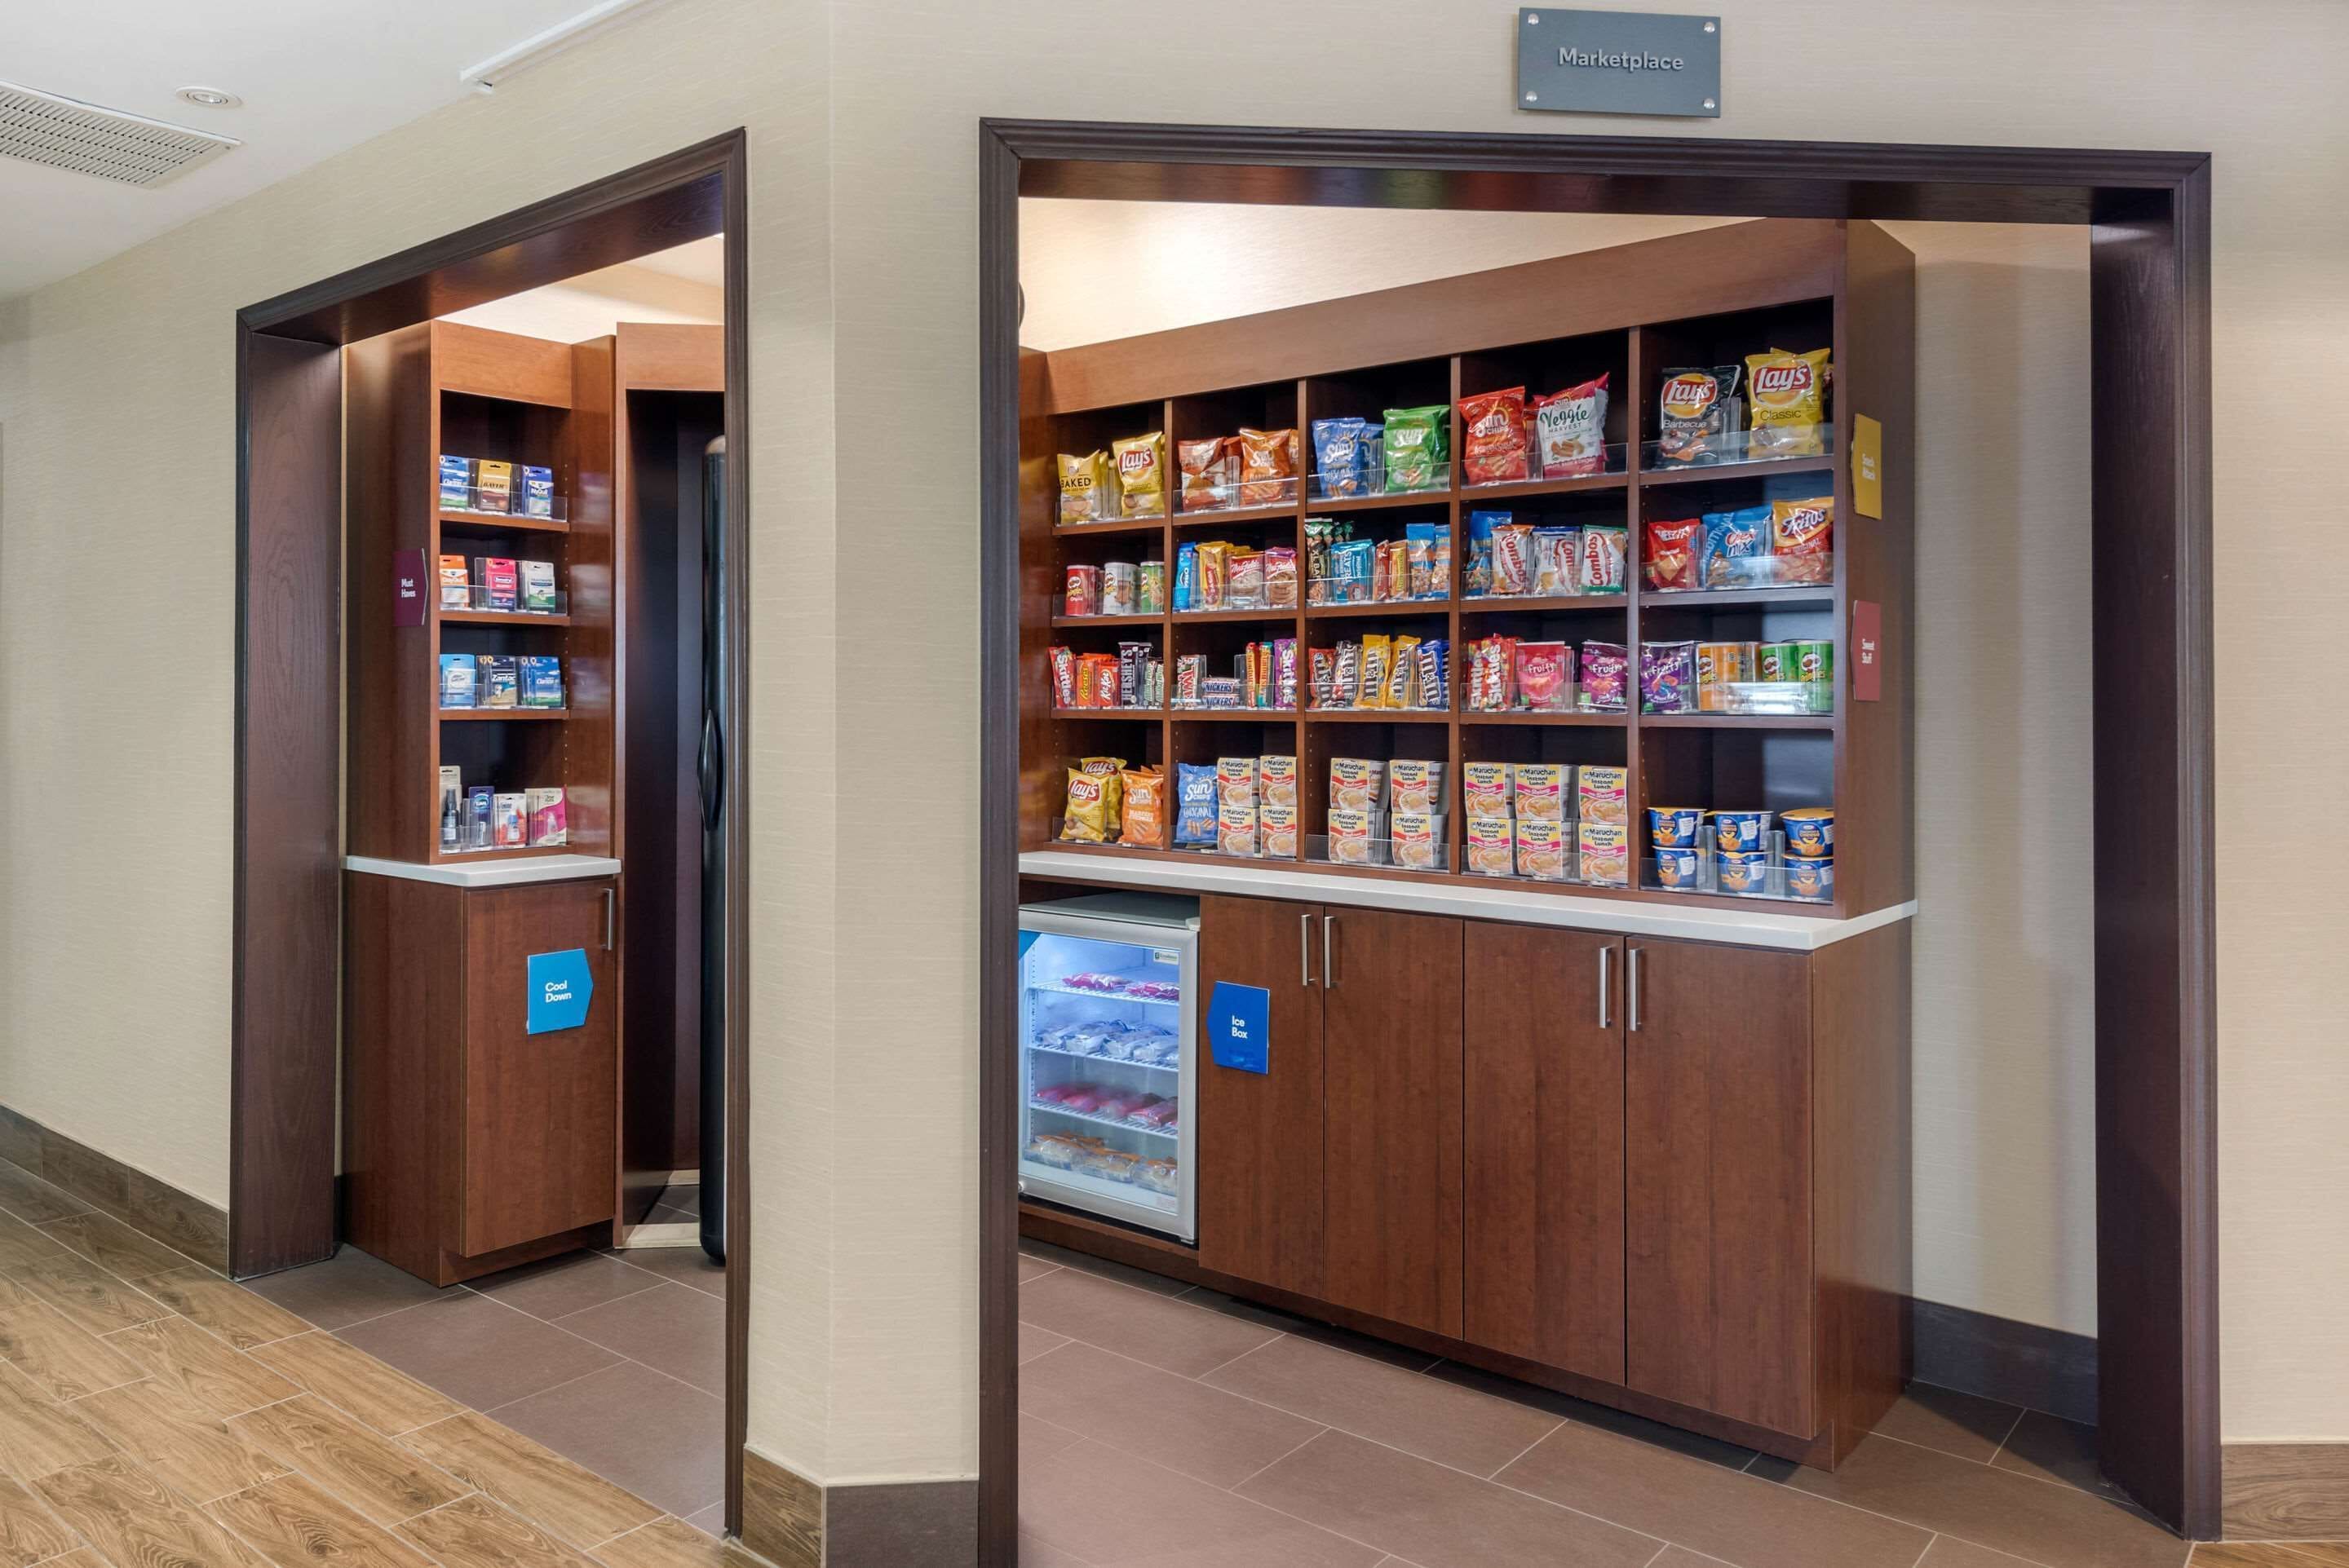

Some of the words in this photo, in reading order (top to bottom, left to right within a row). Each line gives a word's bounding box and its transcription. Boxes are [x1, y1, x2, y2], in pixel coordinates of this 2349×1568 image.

[1558, 47, 1684, 72] Marketplace
[1755, 365, 1808, 394] Lay's
[1540, 404, 1590, 428] Veggie
[1760, 409, 1802, 422] Classic
[1548, 422, 1582, 433] HARVEST
[1663, 420, 1707, 429] Barbecue
[1121, 447, 1151, 473] Lay's
[1060, 477, 1091, 489] BAKED
[1586, 536, 1604, 585] Combos
[400, 578, 414, 588] Must
[400, 588, 416, 598] Haves
[1121, 649, 1133, 700] HERSHEY'S
[1339, 762, 1365, 771] Maruchan
[1590, 771, 1621, 780] Maruchan
[1070, 780, 1098, 800] Lay's
[1338, 813, 1364, 821] Maruchan
[1476, 821, 1506, 829] Maruchan
[545, 979, 568, 992] Cool
[545, 992, 572, 1004] Down
[1232, 1014, 1245, 1027] Ice
[1232, 1027, 1249, 1040] Box
